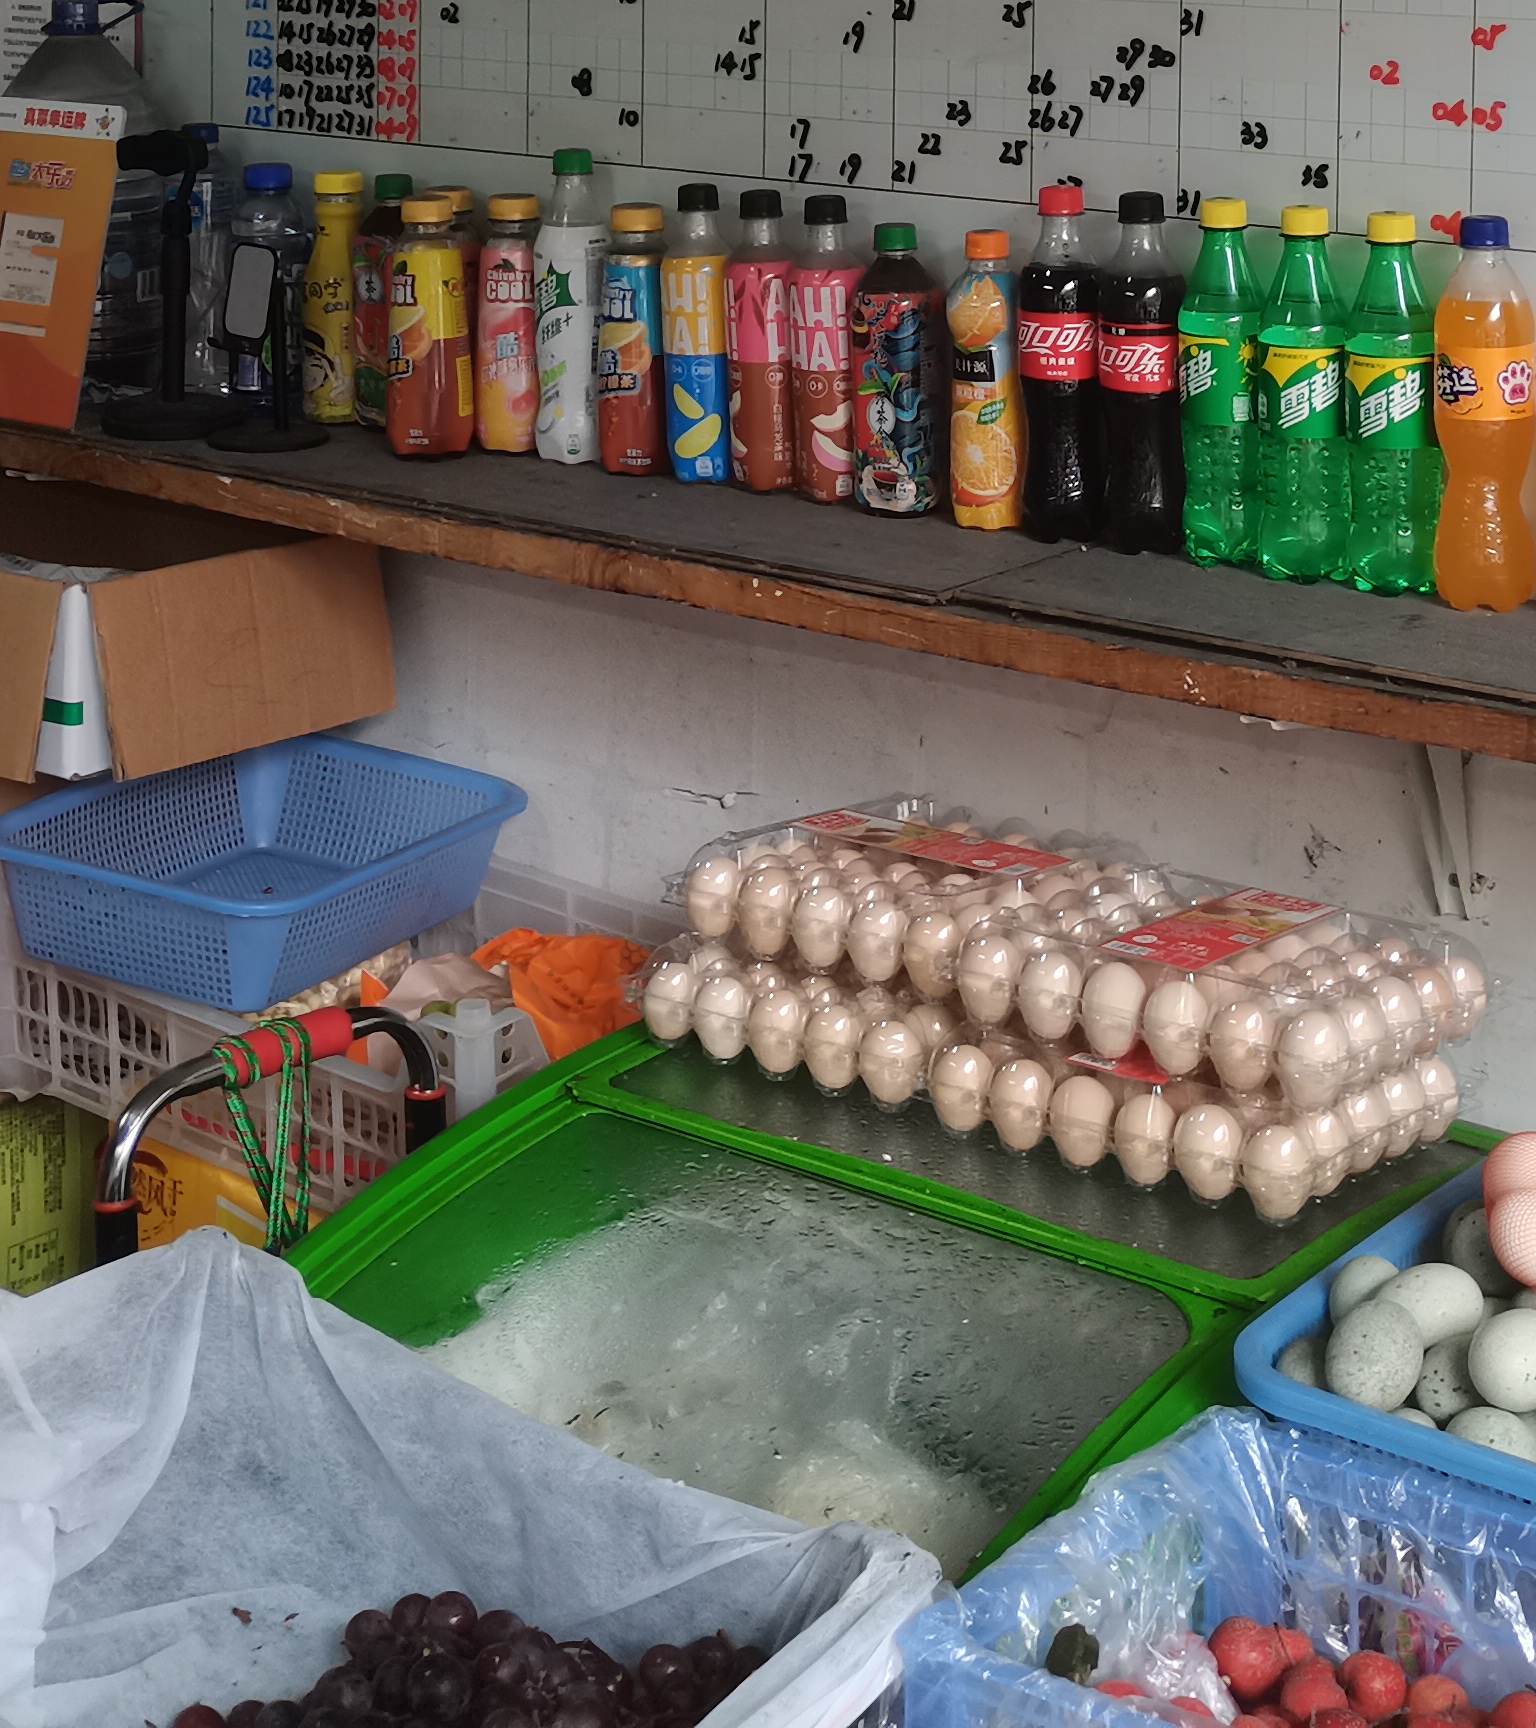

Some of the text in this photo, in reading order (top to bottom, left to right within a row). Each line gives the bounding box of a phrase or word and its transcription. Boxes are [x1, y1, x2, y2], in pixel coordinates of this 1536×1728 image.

[24, 108, 87, 130] 真票幸运牌
[618, 106, 639, 127] 10
[486, 281, 534, 303] COOL
[790, 286, 847, 327] AH!
[792, 329, 849, 372] HA!
[1279, 358, 1343, 429] 雪碧
[1358, 367, 1426, 438] 雪碧
[1437, 363, 1480, 403] 芬达
